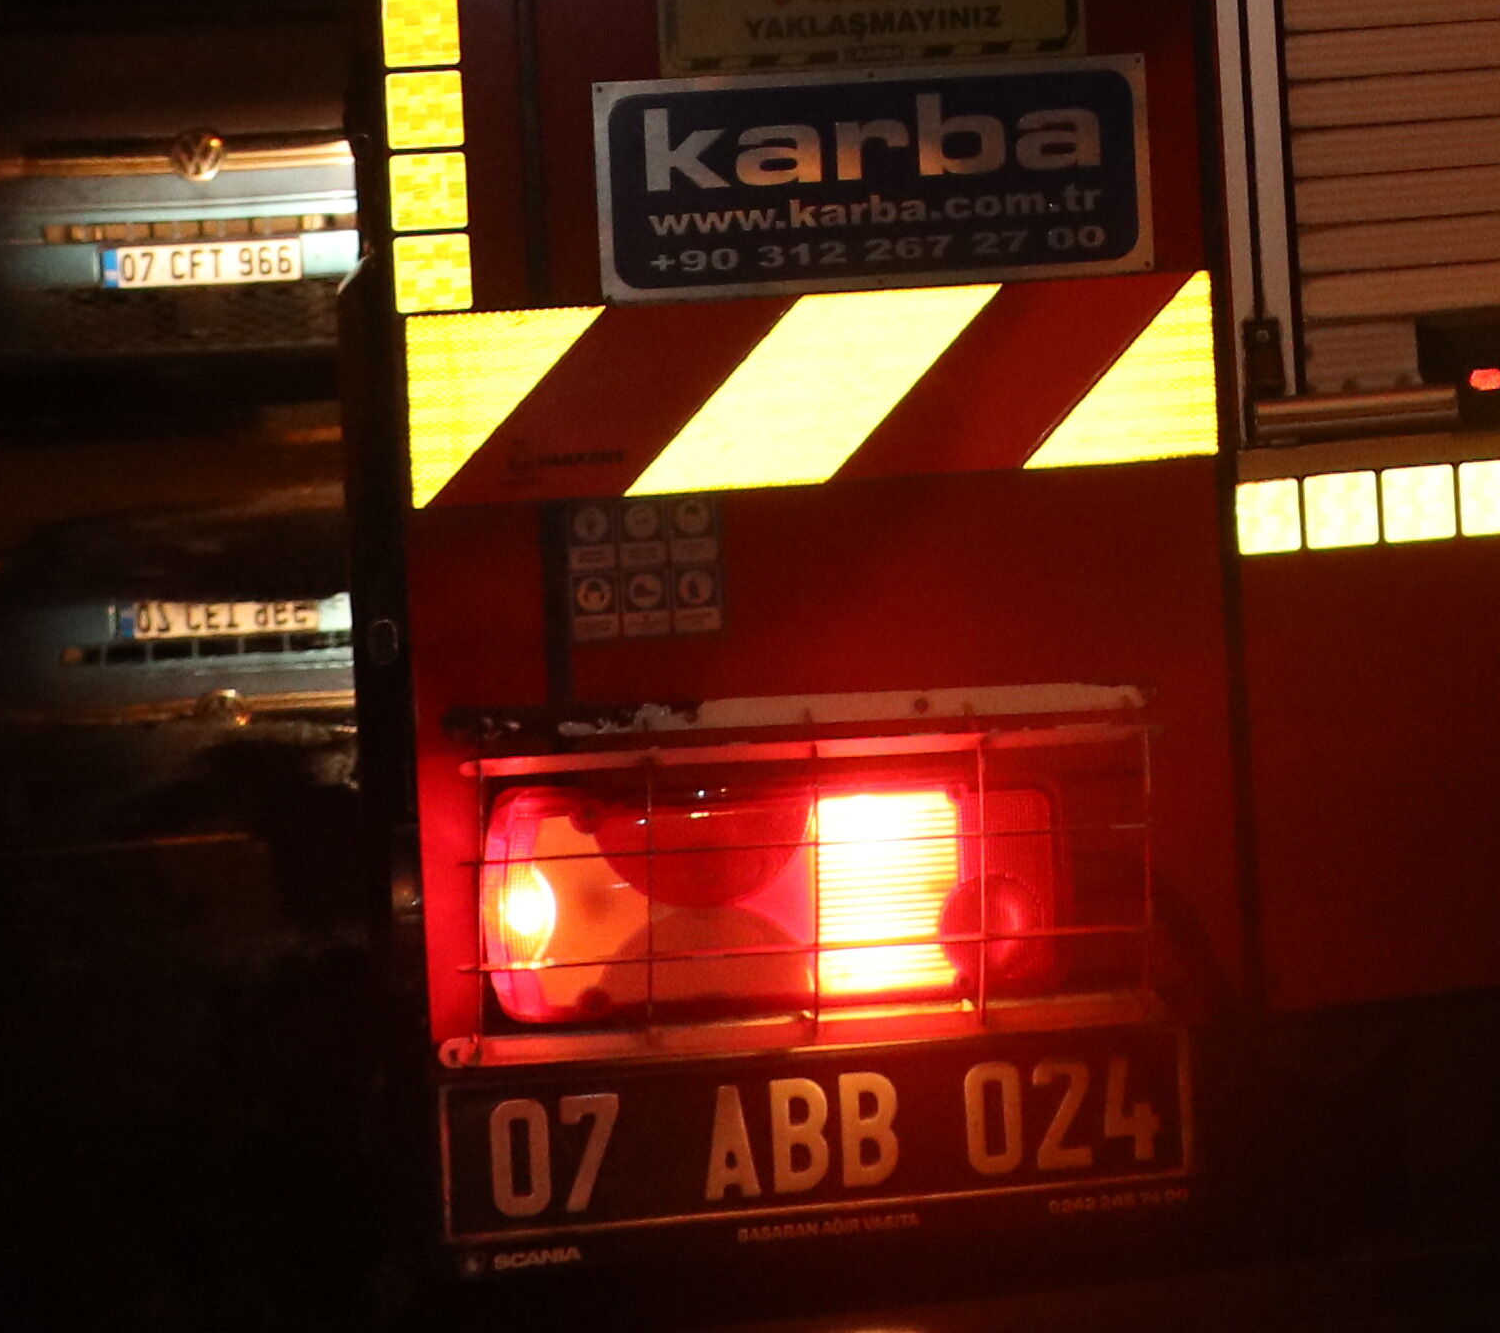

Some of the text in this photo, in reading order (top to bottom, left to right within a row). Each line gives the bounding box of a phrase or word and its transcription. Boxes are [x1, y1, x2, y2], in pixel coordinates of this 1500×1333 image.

[744, 5, 1002, 41] YAKLAŞMAYINIZ
[643, 92, 1102, 193] karba
[648, 183, 1101, 237] www.karba.com.tr
[122, 246, 292, 282] 07 CFT 966
[649, 225, 1106, 274] +90 312 267 27 00
[488, 1056, 1162, 1218] 07 ABB 024
[494, 1246, 582, 1271] SCANIA
